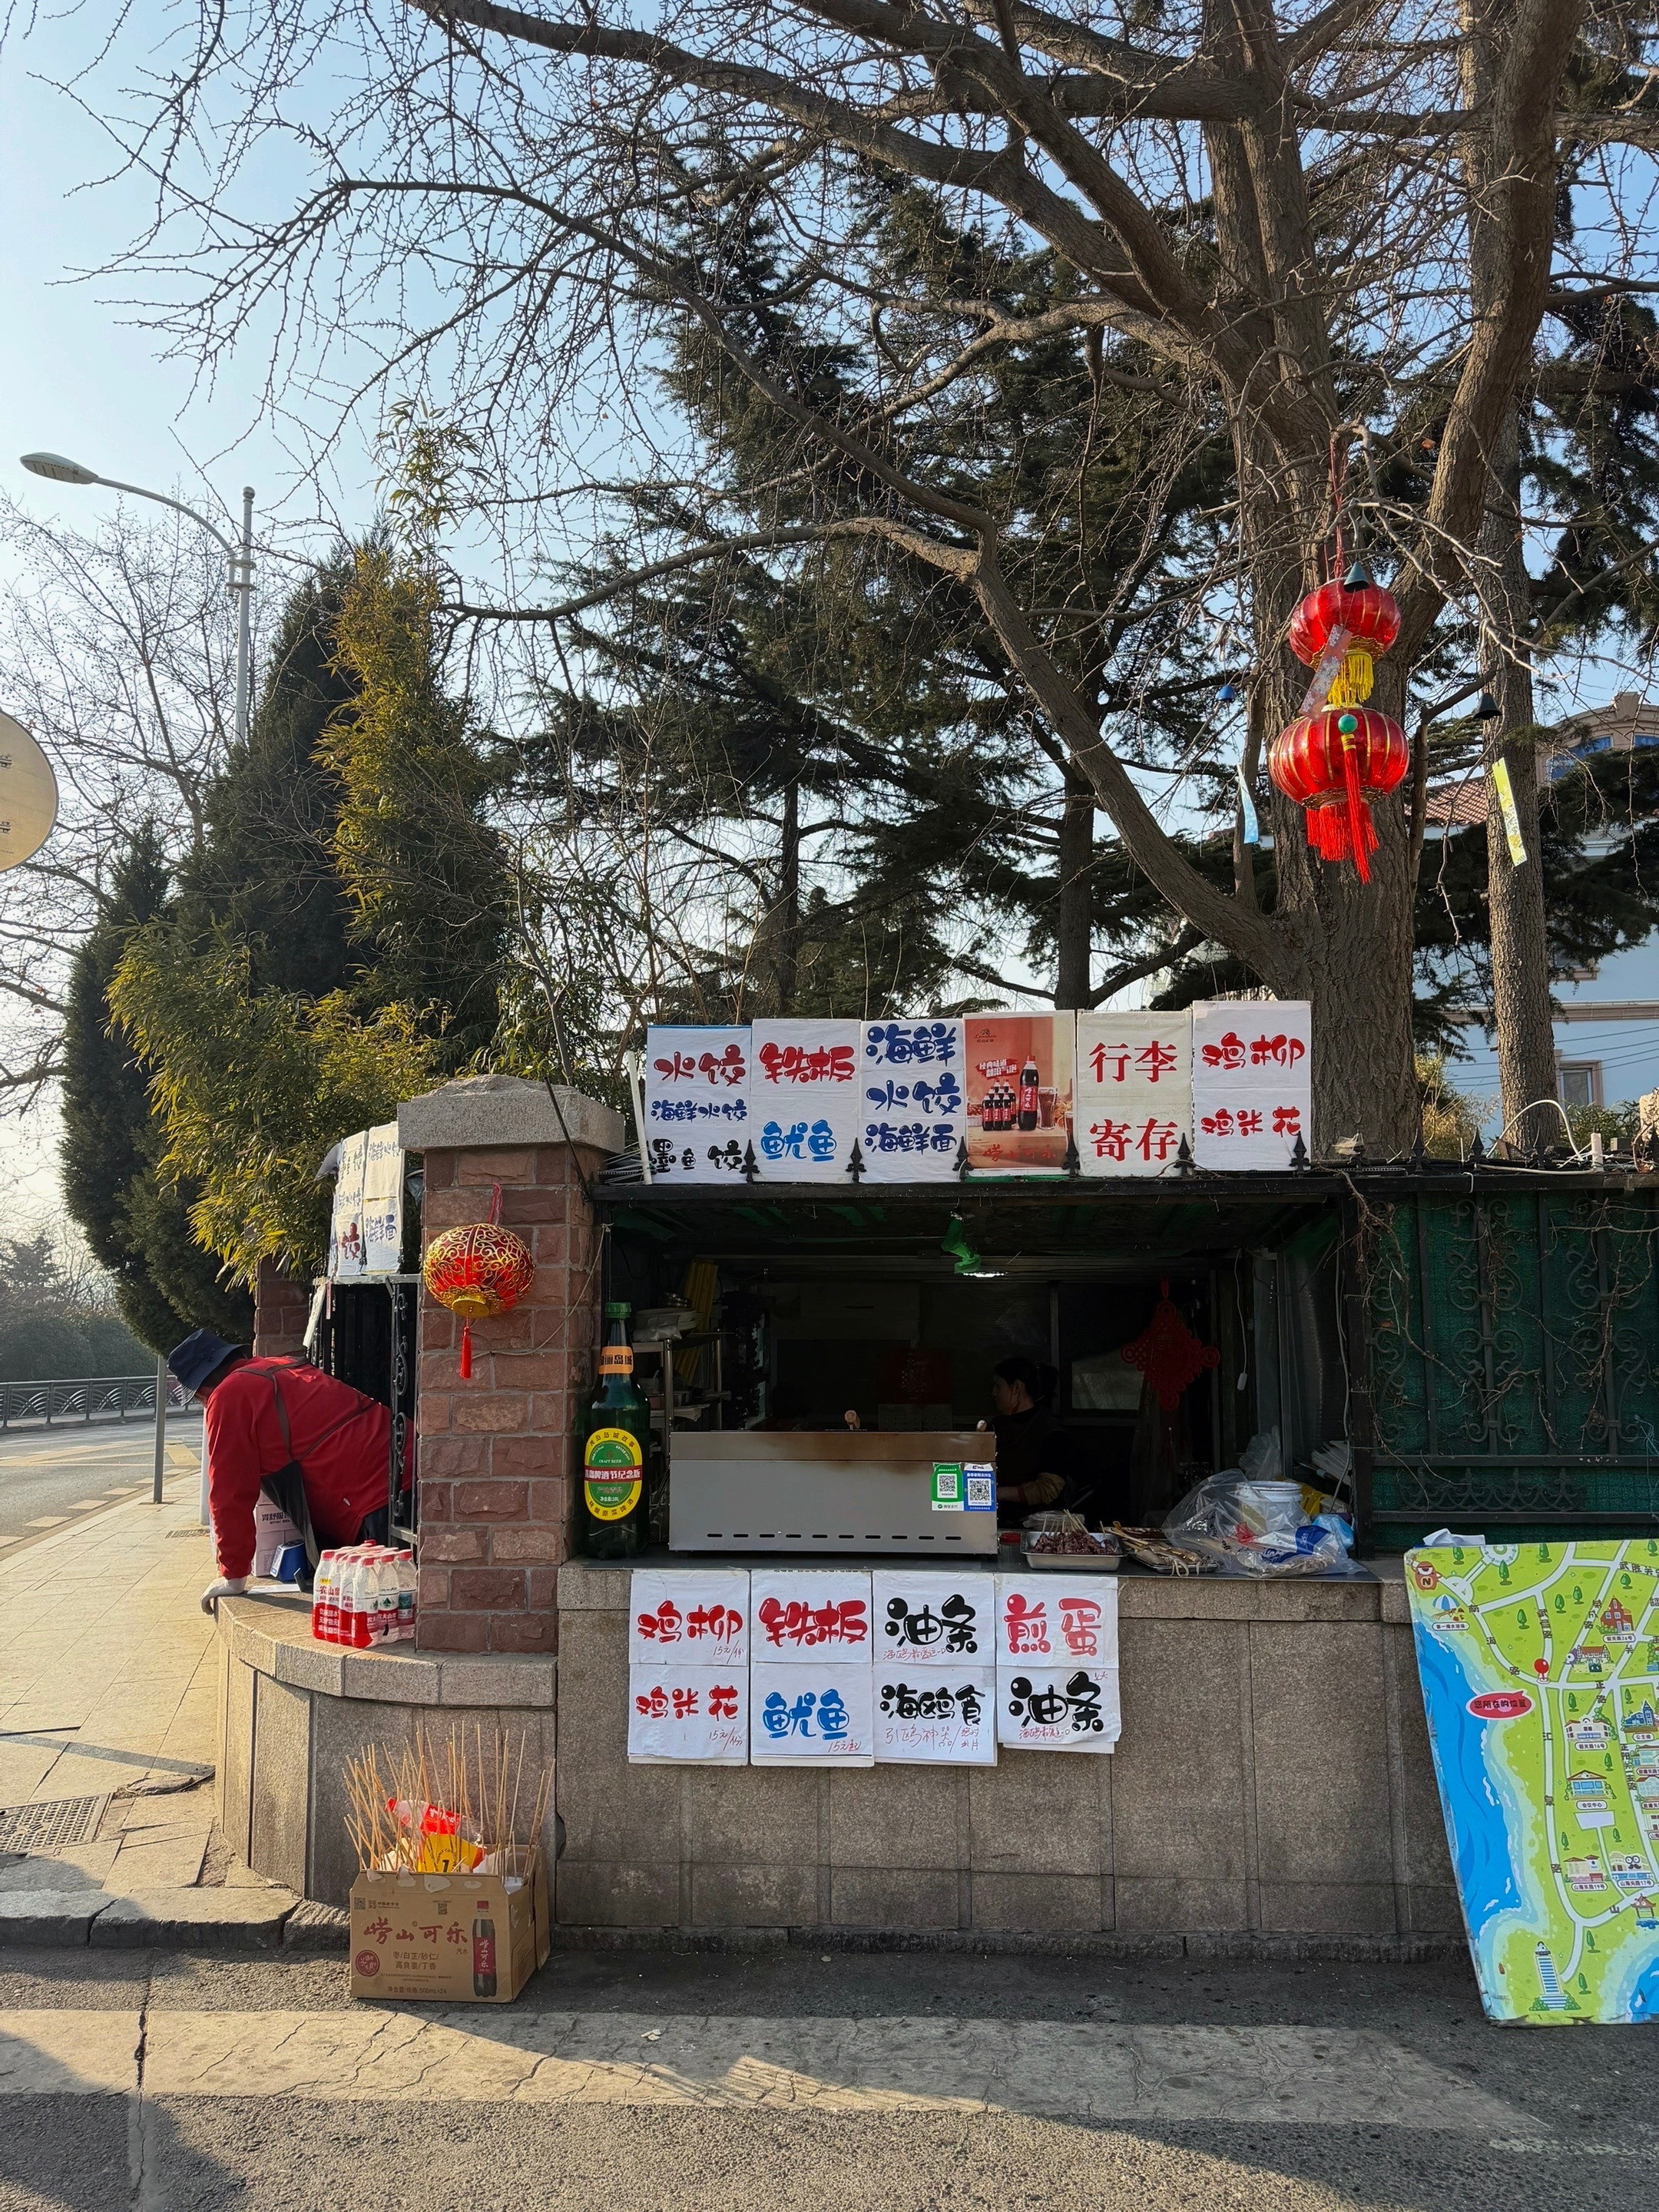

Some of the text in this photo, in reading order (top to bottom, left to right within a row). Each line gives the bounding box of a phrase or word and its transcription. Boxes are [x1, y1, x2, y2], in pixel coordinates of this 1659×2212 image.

[653, 1044, 747, 1087] 水饺
[759, 1041, 855, 1084] 铁板
[866, 1022, 957, 1066] 海鲜
[1089, 1040, 1178, 1083] 行李
[1201, 1031, 1306, 1071] 鸡柳
[651, 1098, 748, 1121] 海鲜水饺
[866, 1072, 962, 1115] 水饺
[760, 1119, 837, 1162] 鱿鱼
[864, 1122, 957, 1154] 海鲜面
[1089, 1118, 1178, 1162] 寄存
[1200, 1105, 1301, 1137] 鸡米花
[637, 1600, 743, 1644] 鸡柳
[759, 1597, 868, 1647] 铁板
[885, 1594, 978, 1653] 油条
[1003, 1593, 1102, 1657] 煎蛋
[636, 1685, 738, 1721] 鸡米花
[763, 1689, 849, 1740] 鱿鱼
[1008, 1671, 1104, 1732] 油条
[363, 1916, 469, 1945] 崂山可乐
